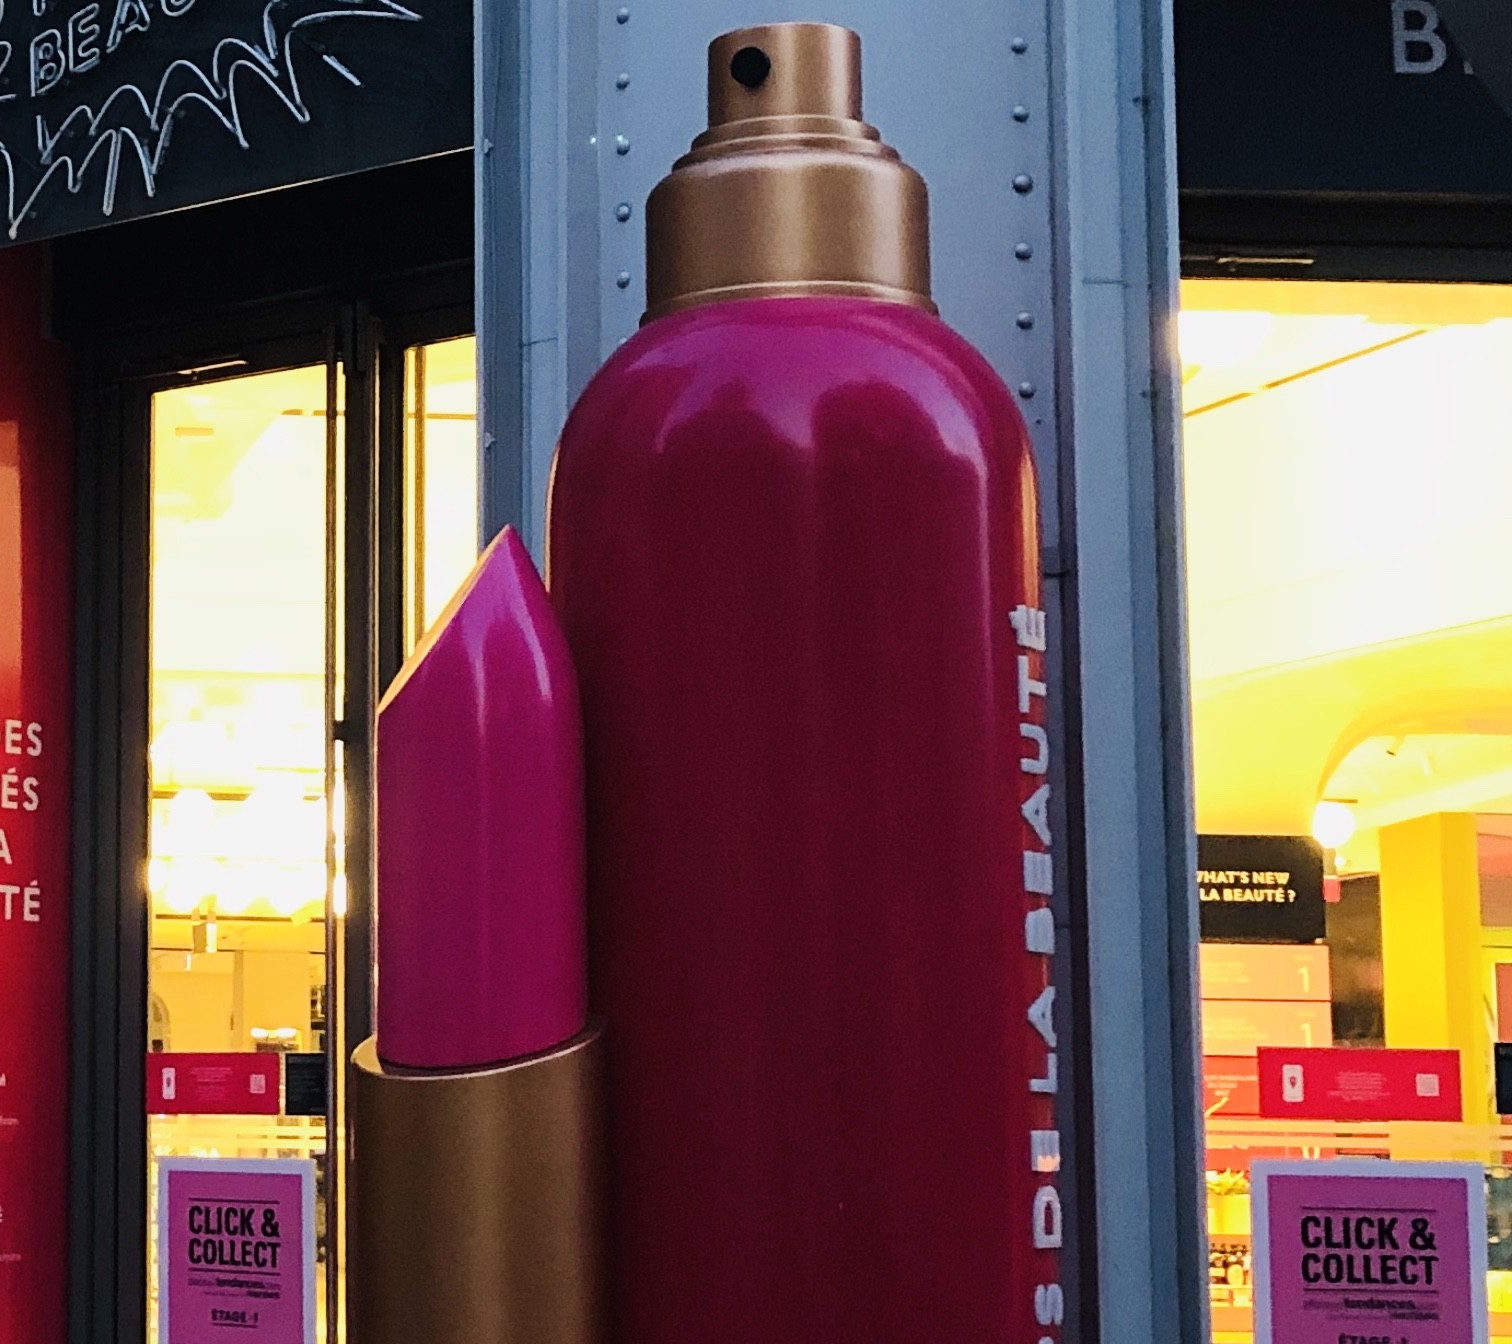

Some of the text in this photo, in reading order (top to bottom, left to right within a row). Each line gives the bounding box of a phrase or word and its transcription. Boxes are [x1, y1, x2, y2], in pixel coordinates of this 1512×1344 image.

[1009, 604, 1056, 955] BEAUTÉ
[1252, 871, 1290, 885] NEW
[1199, 888, 1220, 902] LA
[1223, 887, 1285, 903] BEAUTÉ
[1028, 985, 1058, 1094] LA
[1030, 1129, 1062, 1250] DE
[188, 1205, 280, 1238] CLICK &
[1301, 1215, 1437, 1251] CLICK &
[188, 1238, 281, 1269] COLLECT
[1301, 1253, 1439, 1286] COLLECT
